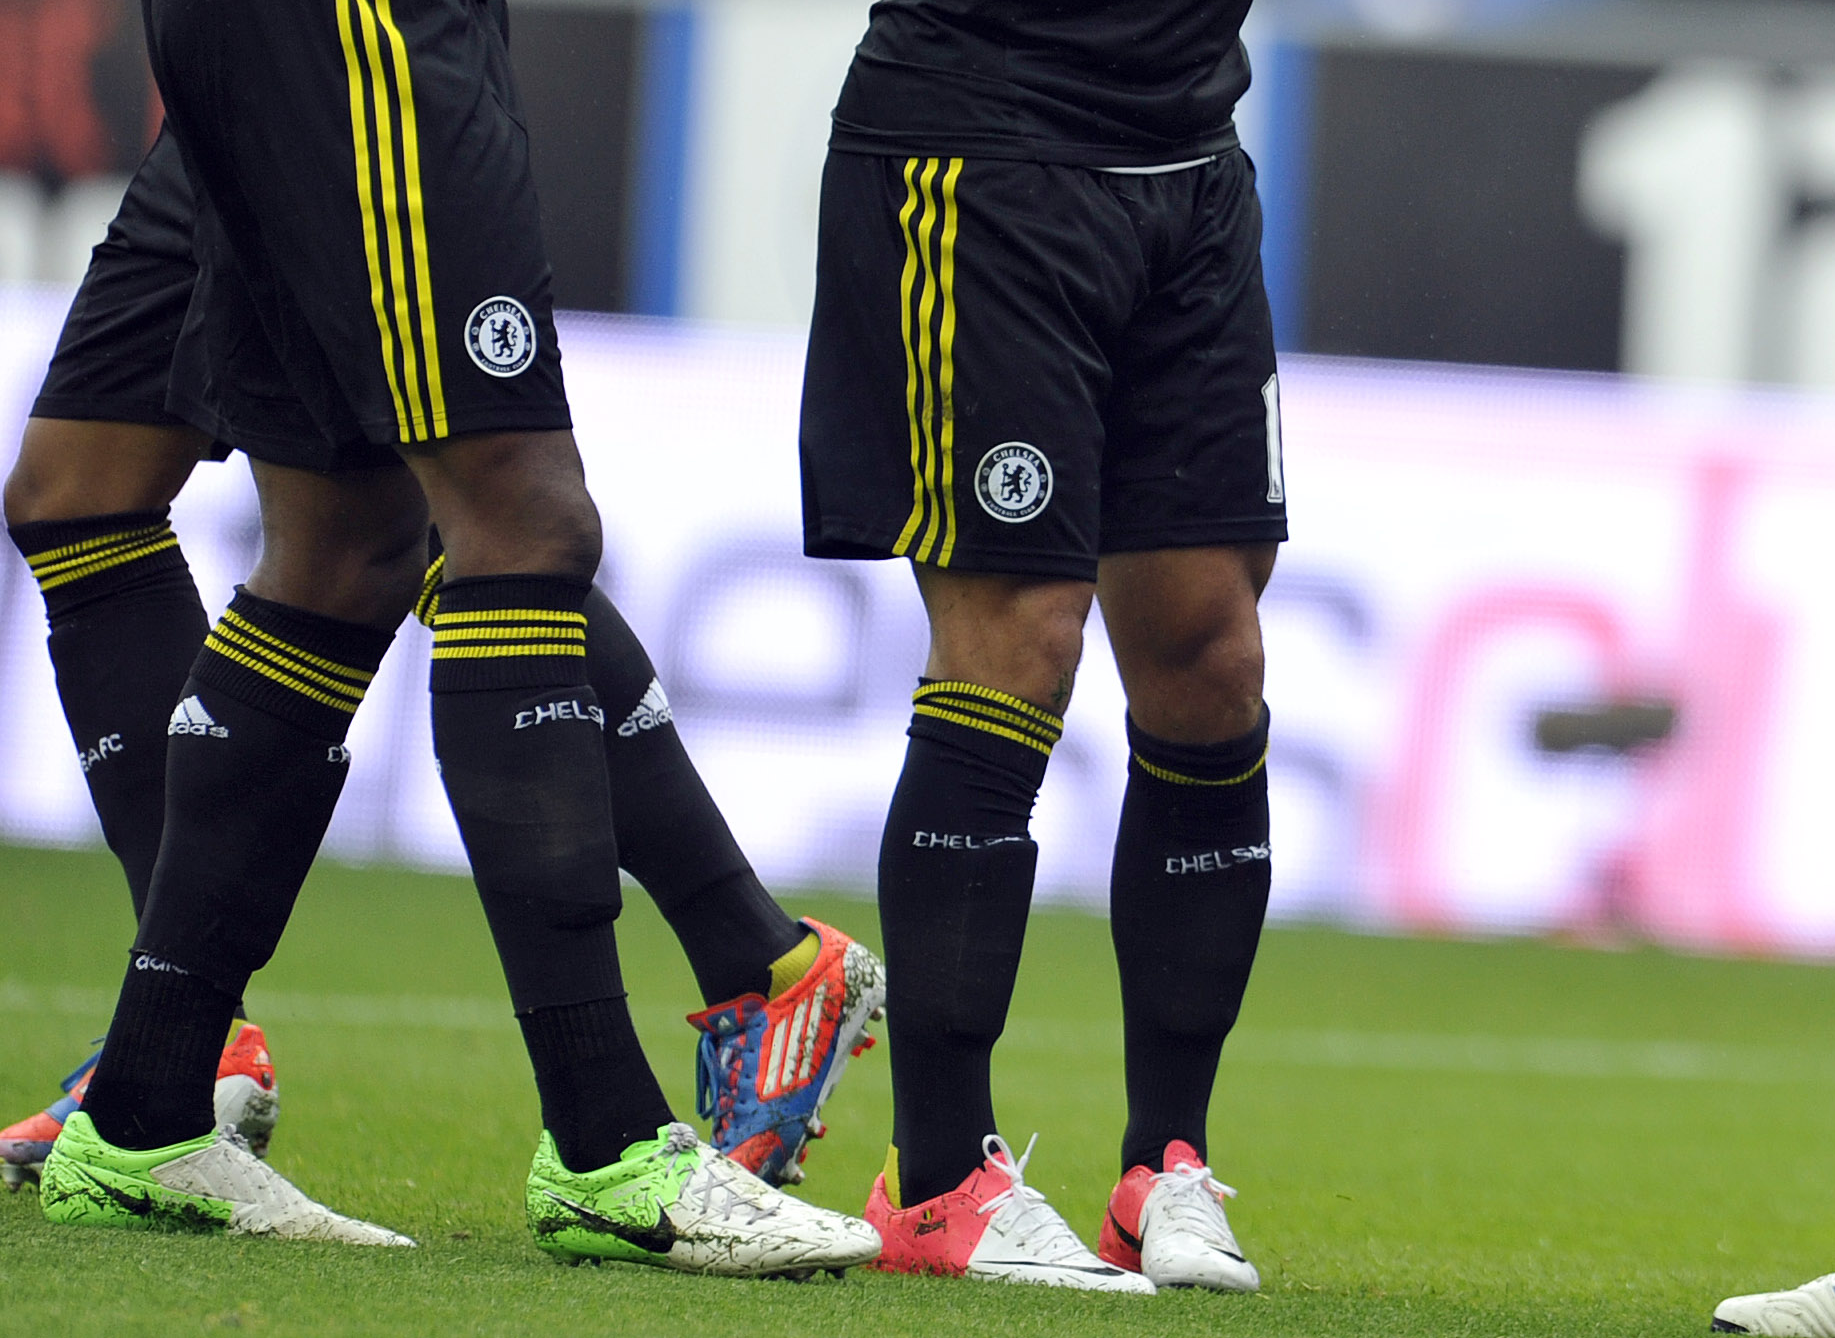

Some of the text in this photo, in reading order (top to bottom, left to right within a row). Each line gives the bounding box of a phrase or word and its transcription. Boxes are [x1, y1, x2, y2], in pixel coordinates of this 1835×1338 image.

[479, 303, 522, 321] CHELSEA
[992, 448, 1041, 468] CHELSEA
[99, 733, 124, 759] FC
